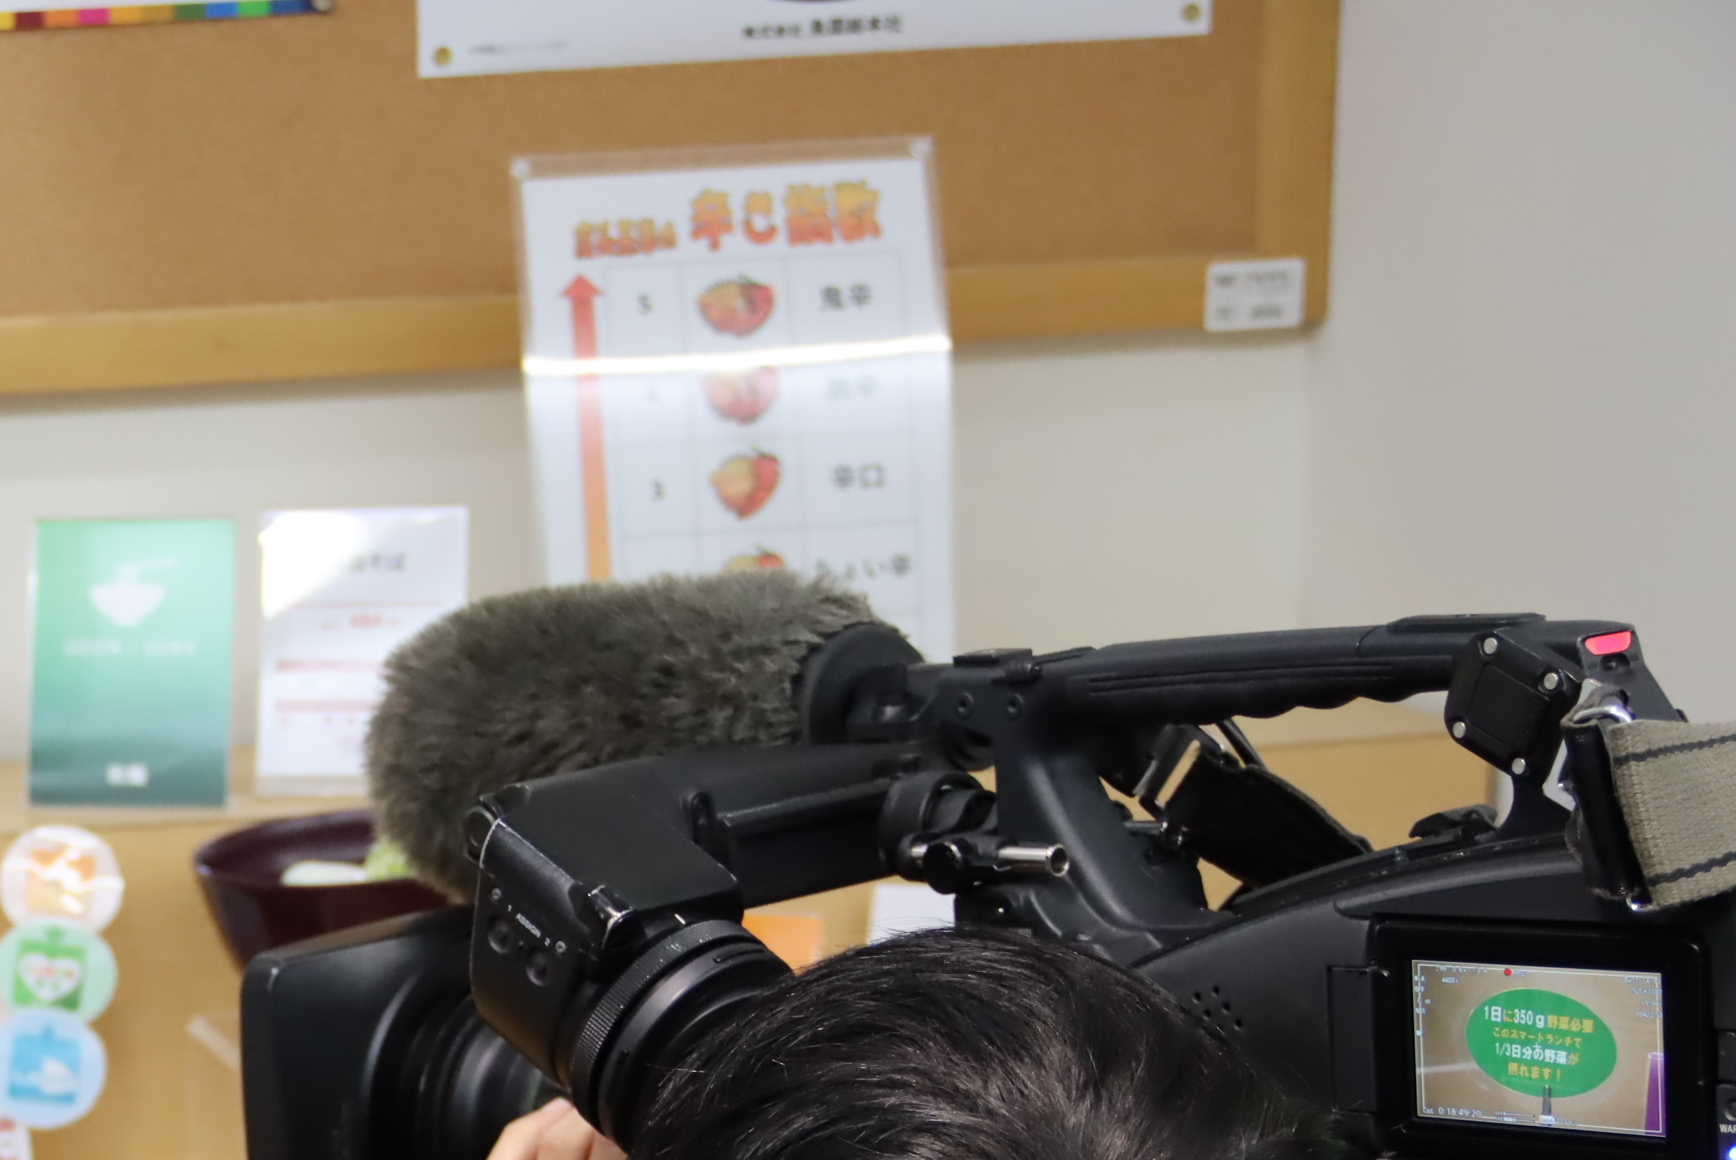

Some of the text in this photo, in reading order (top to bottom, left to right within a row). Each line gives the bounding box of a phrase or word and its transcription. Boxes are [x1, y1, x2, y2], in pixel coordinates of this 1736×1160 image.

[1495, 1042, 1580, 1065] 1/3日分の野菜が
